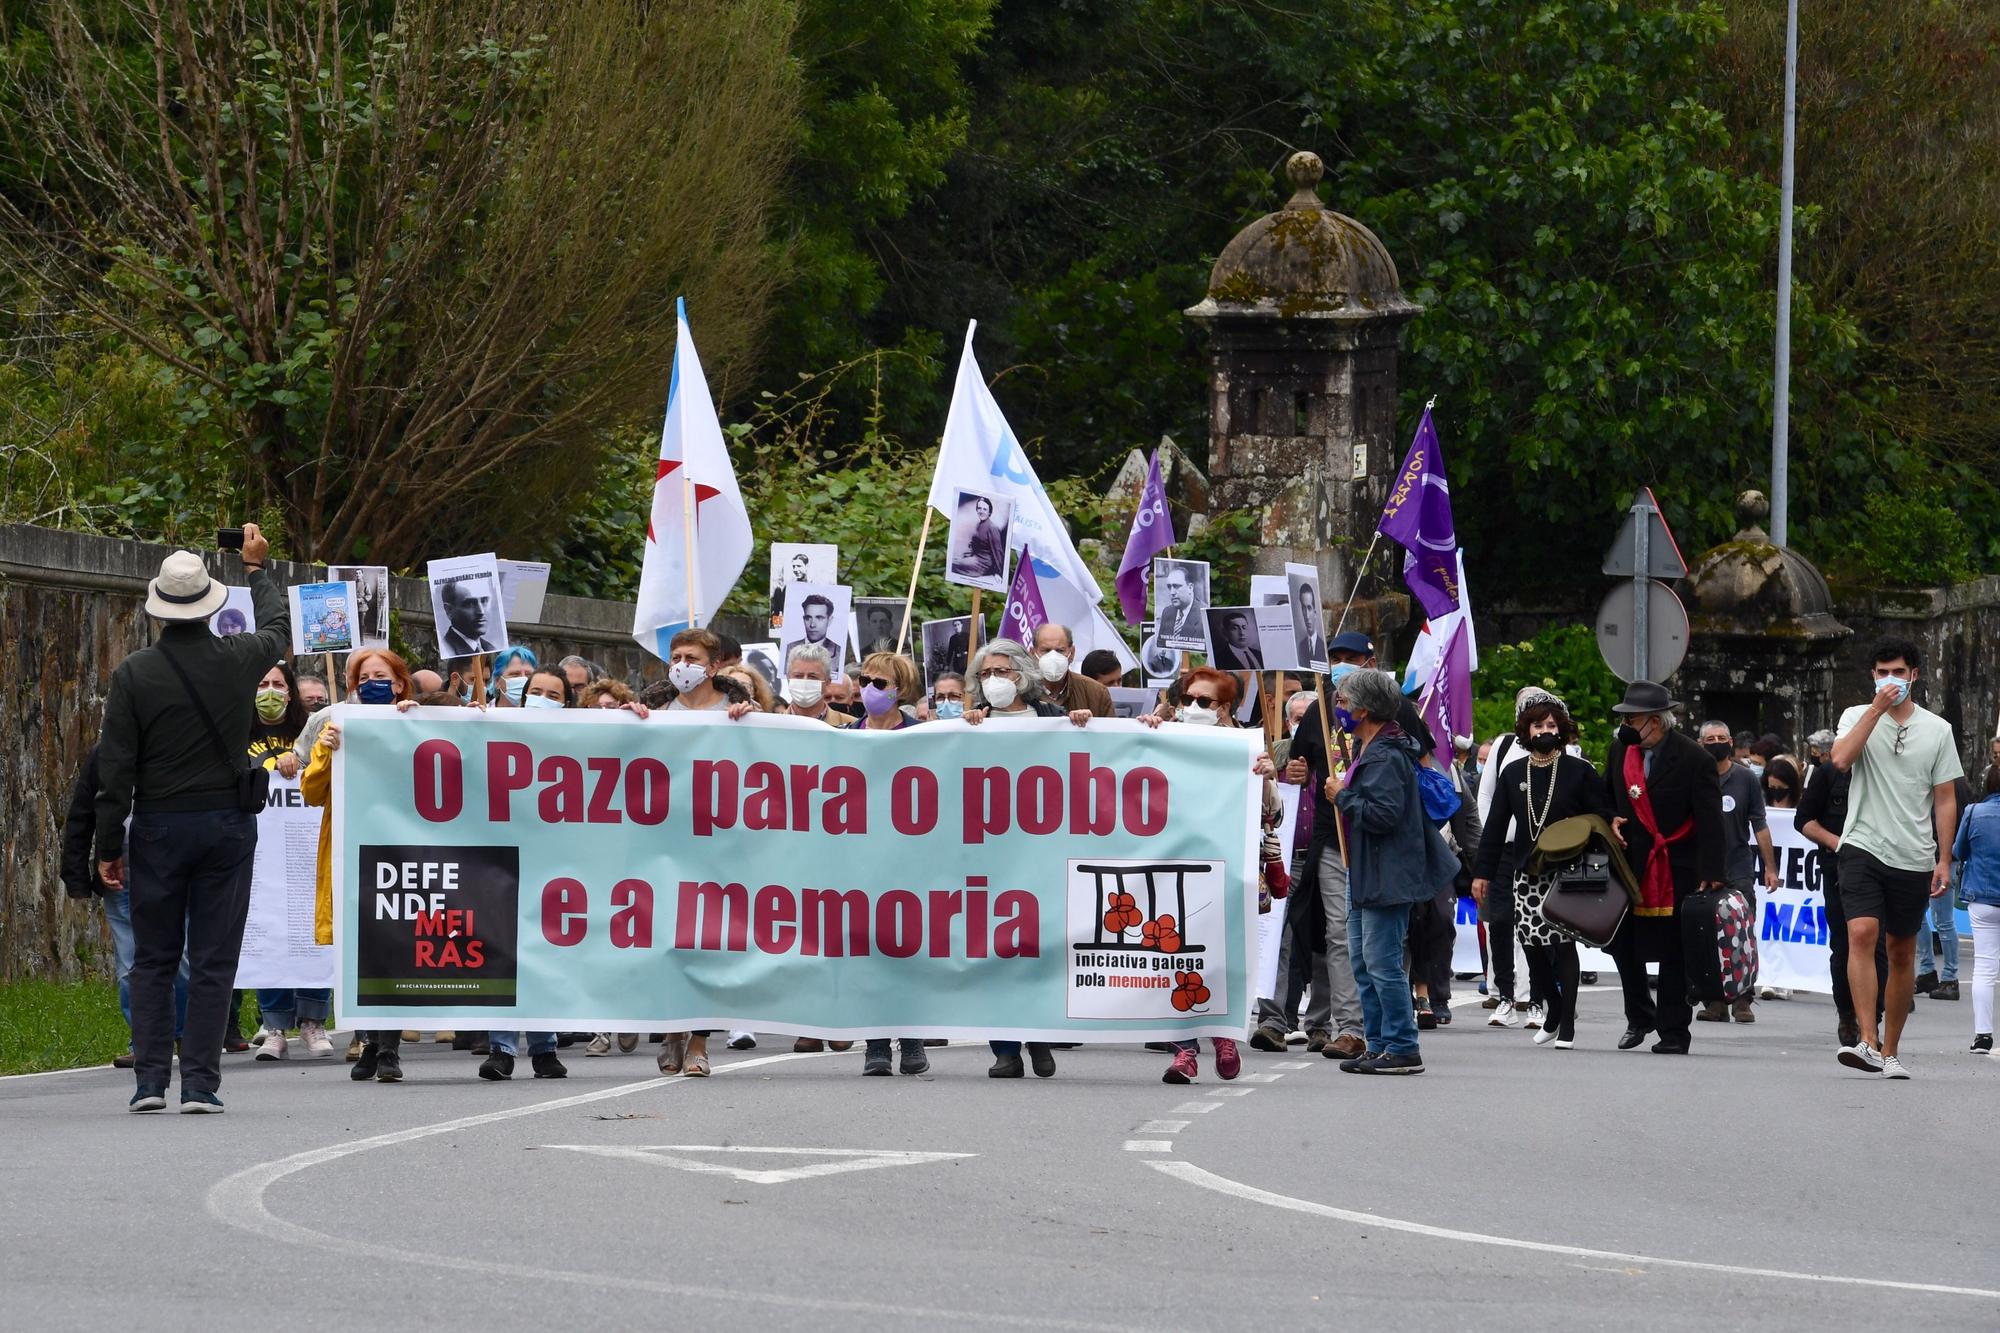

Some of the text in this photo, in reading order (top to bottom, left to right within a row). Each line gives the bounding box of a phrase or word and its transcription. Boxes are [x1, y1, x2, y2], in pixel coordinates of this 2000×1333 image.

[413, 740, 1168, 843] O Pazo para o pobo
[376, 862, 459, 889] DEFE
[376, 893, 446, 920] NDE
[541, 877, 1039, 957] e a memoria
[415, 909, 474, 937] MEI
[415, 930, 485, 968] RÁS
[1075, 953, 1204, 971] iniciativa galega
[1075, 973, 1170, 988] pola memoria
